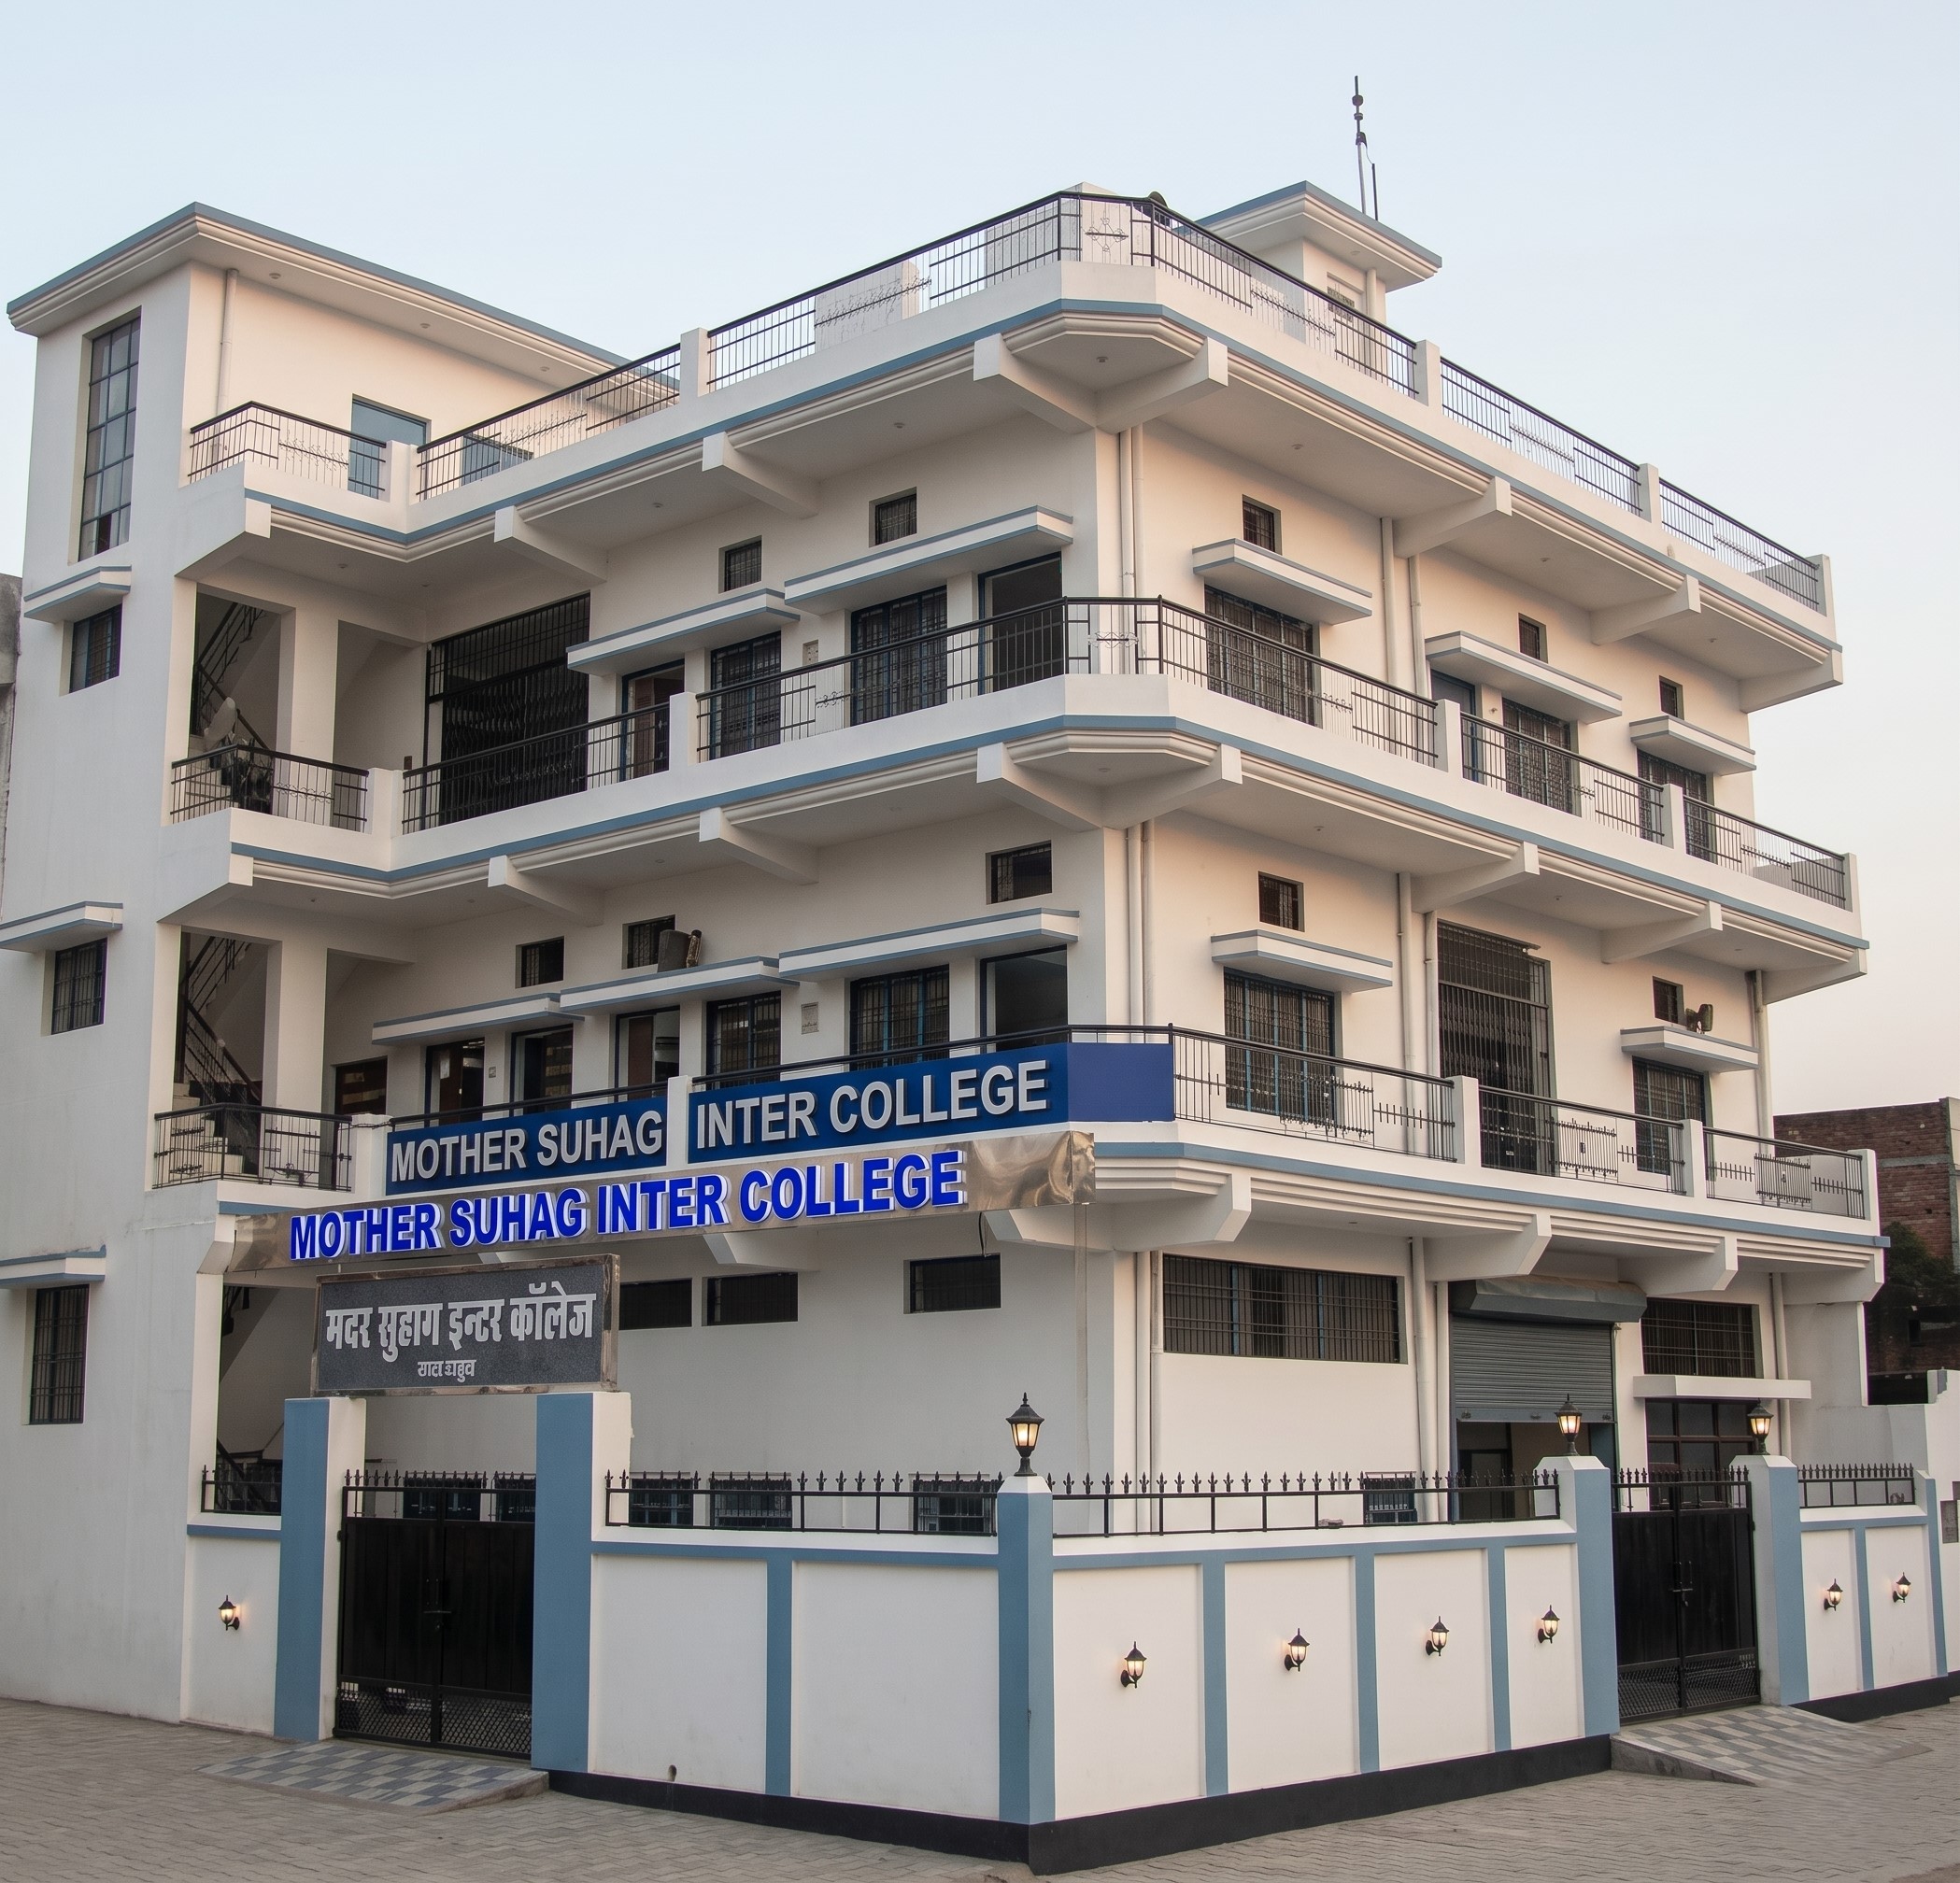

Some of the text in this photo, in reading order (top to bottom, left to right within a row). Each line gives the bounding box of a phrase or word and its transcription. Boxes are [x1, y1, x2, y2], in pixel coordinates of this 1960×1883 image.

[391, 1110, 663, 1182] MOTHER SUHAG
[696, 1060, 1047, 1149] INTER COLLEGE
[290, 1150, 969, 1260] MOTHER SUHAG INTER COLLEGE
[325, 1281, 597, 1363] मदर सुहाग इन्टर कॉलेज
